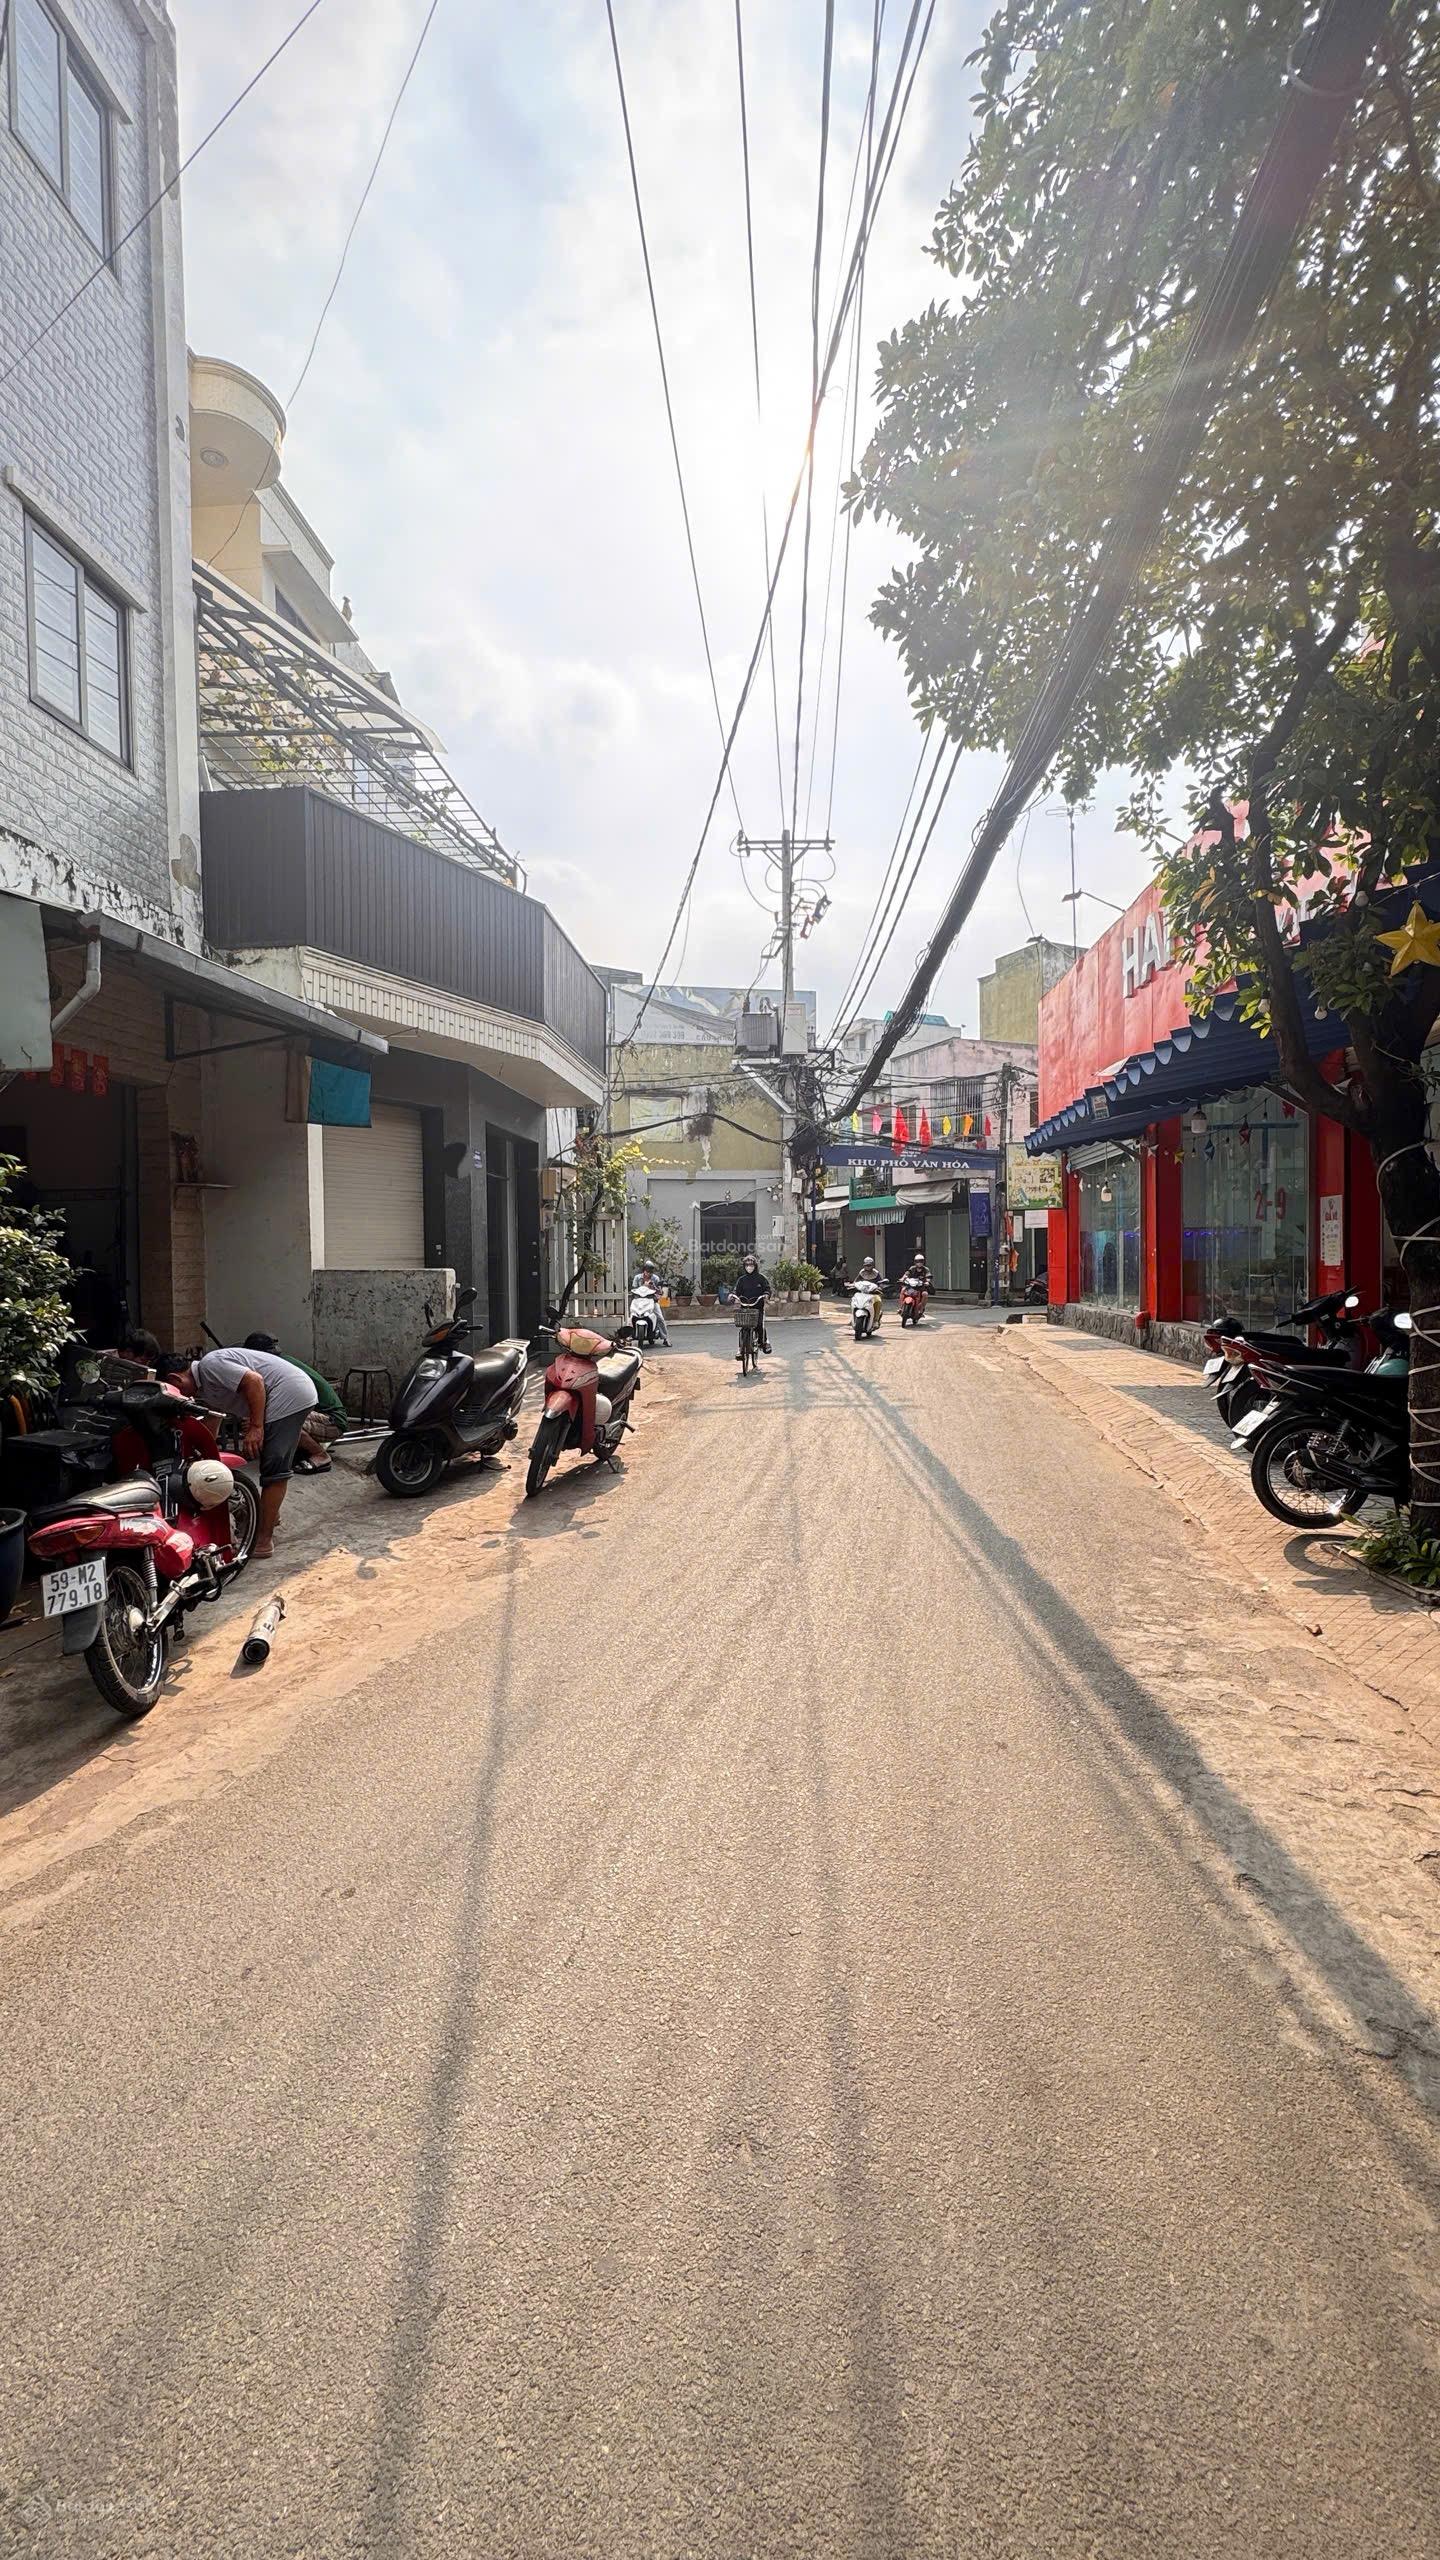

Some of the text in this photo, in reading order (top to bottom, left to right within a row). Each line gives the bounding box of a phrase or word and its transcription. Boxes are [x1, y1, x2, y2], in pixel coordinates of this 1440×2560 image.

[847, 1158, 877, 1167] KHU
[50, 1563, 97, 1592] 59-M2
[47, 1582, 103, 1615] 779.18
